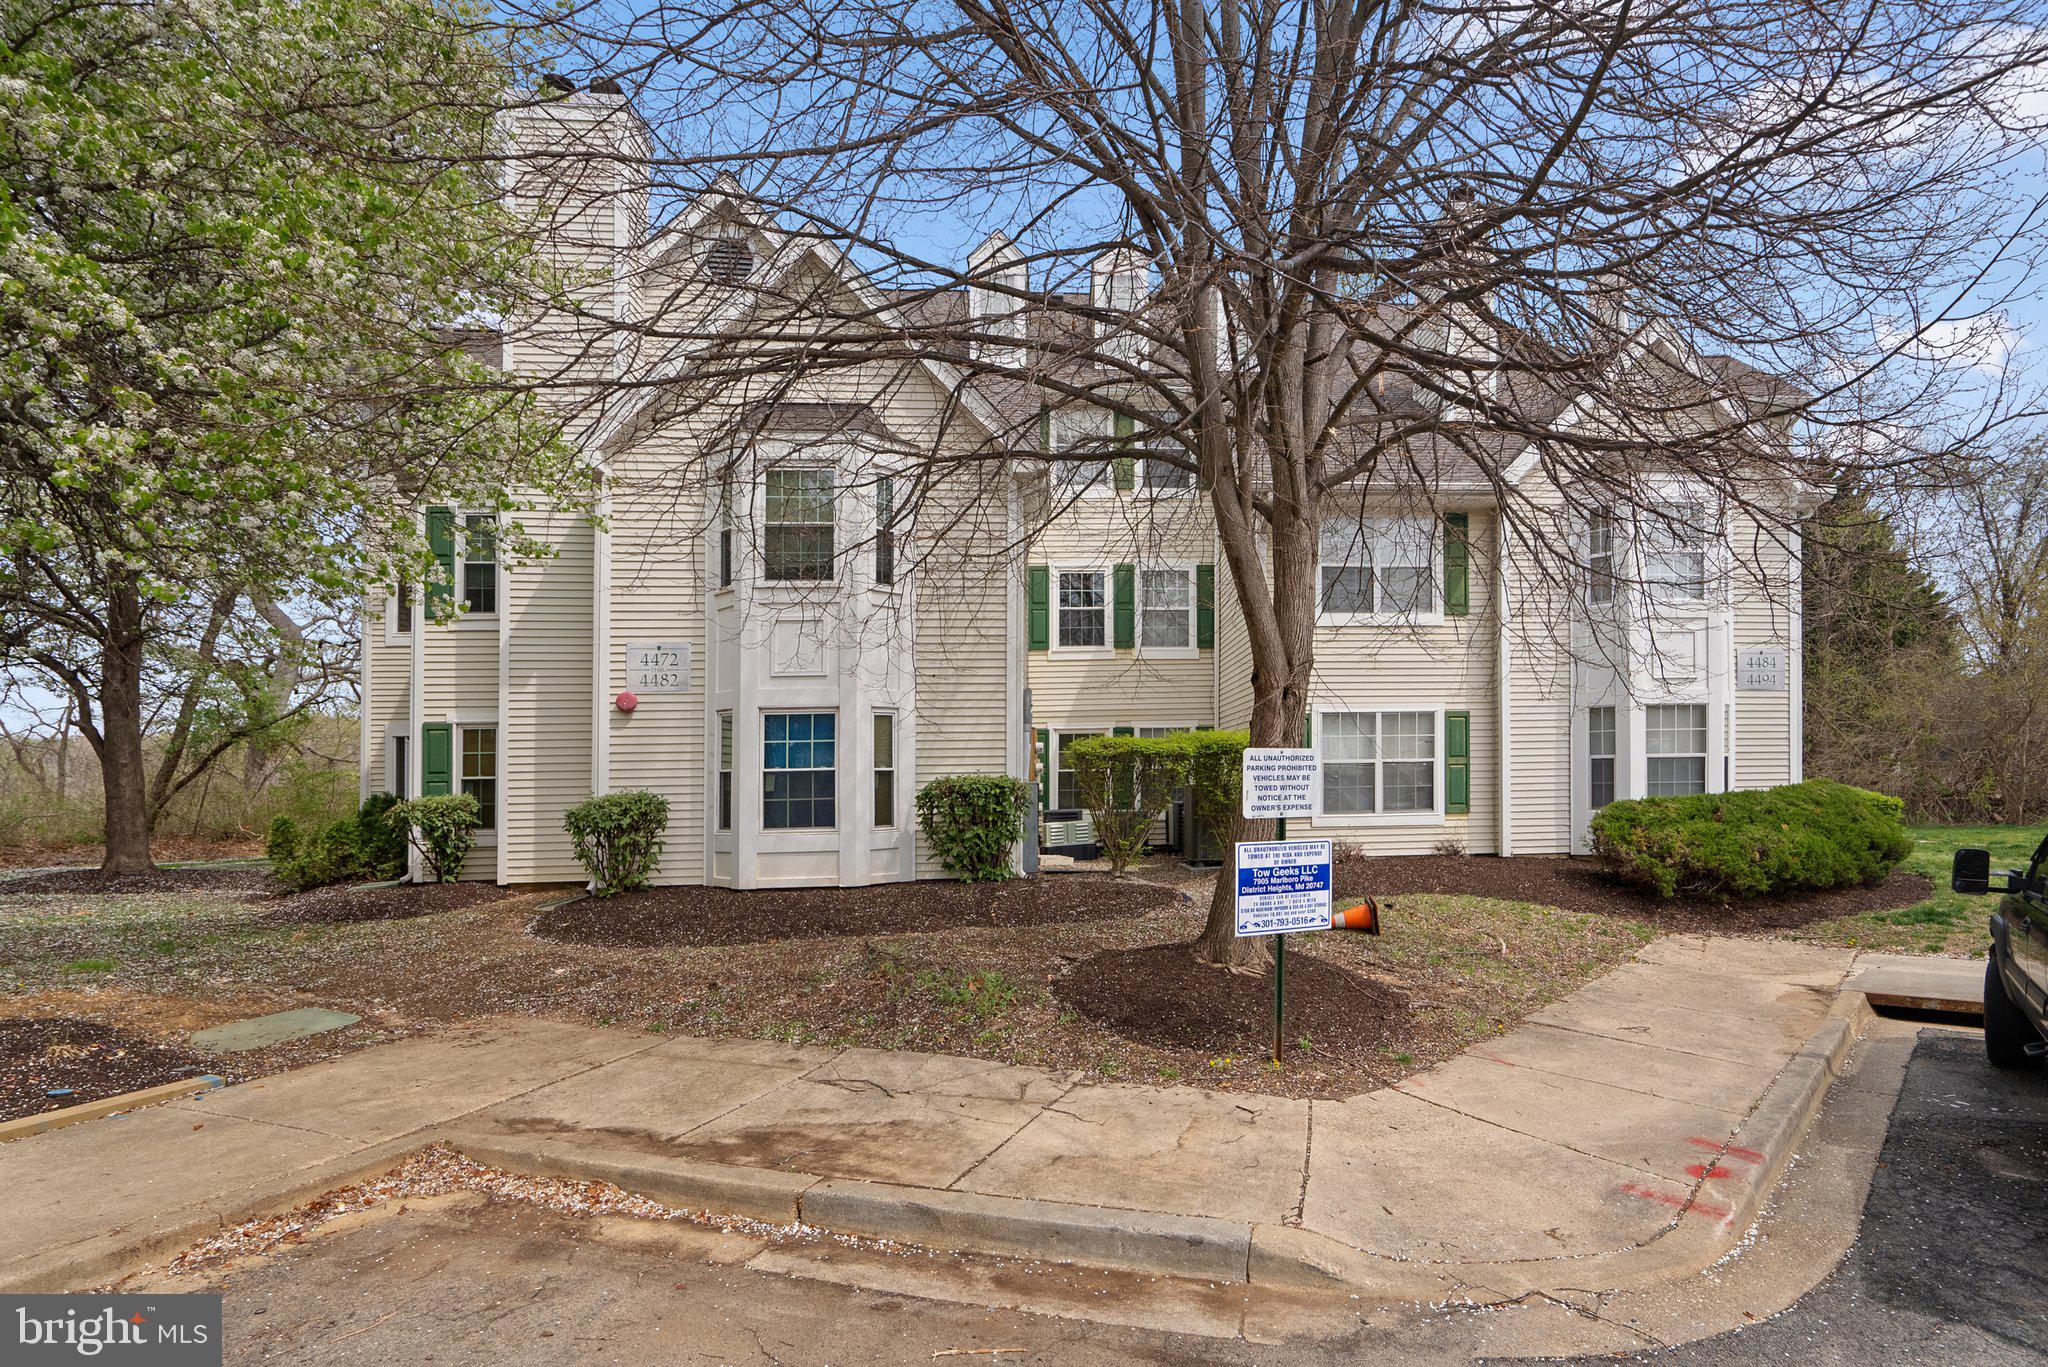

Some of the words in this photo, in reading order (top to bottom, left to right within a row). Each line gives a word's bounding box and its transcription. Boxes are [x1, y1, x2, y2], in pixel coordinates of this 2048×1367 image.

[640, 653, 678, 666] 4472
[1747, 657, 1776, 668] 4484
[640, 674, 679, 687] 4482
[1747, 674, 1776, 685] 4494
[1253, 869, 1270, 877] Tow
[1273, 867, 1299, 876] Geeks
[1301, 866, 1318, 874] LLC
[1268, 884, 1294, 892] Heights,
[1261, 916, 1308, 928] 301-793-0516
